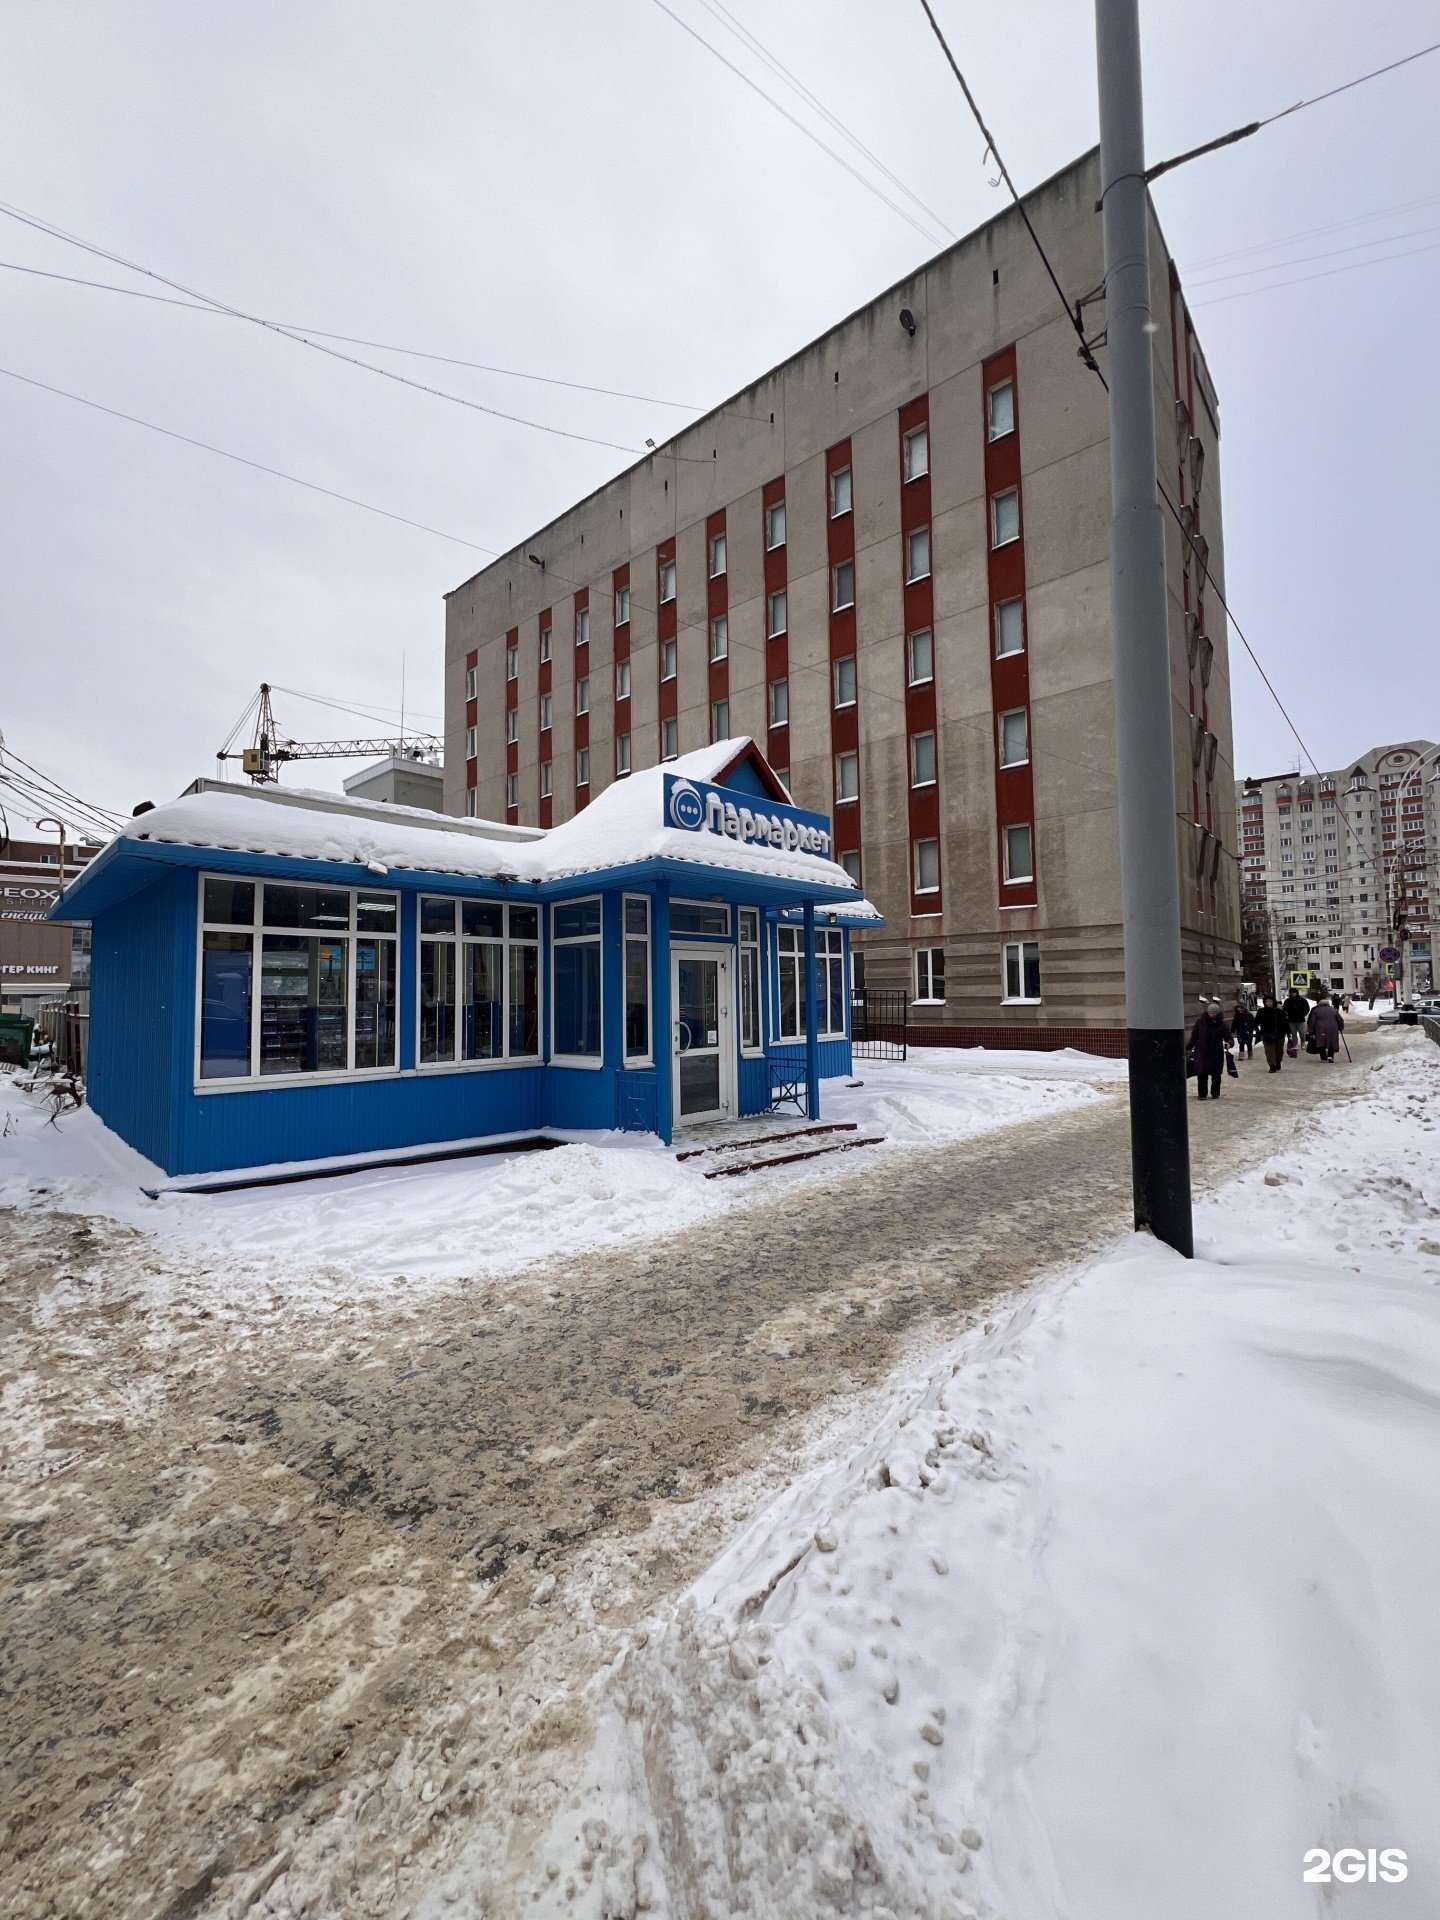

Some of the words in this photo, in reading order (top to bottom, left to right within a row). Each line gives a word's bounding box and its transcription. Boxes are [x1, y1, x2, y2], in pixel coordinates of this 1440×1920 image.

[0, 888, 58, 899] EOX
[0, 965, 25, 974] ГЕР
[26, 965, 59, 974] КИНГ
